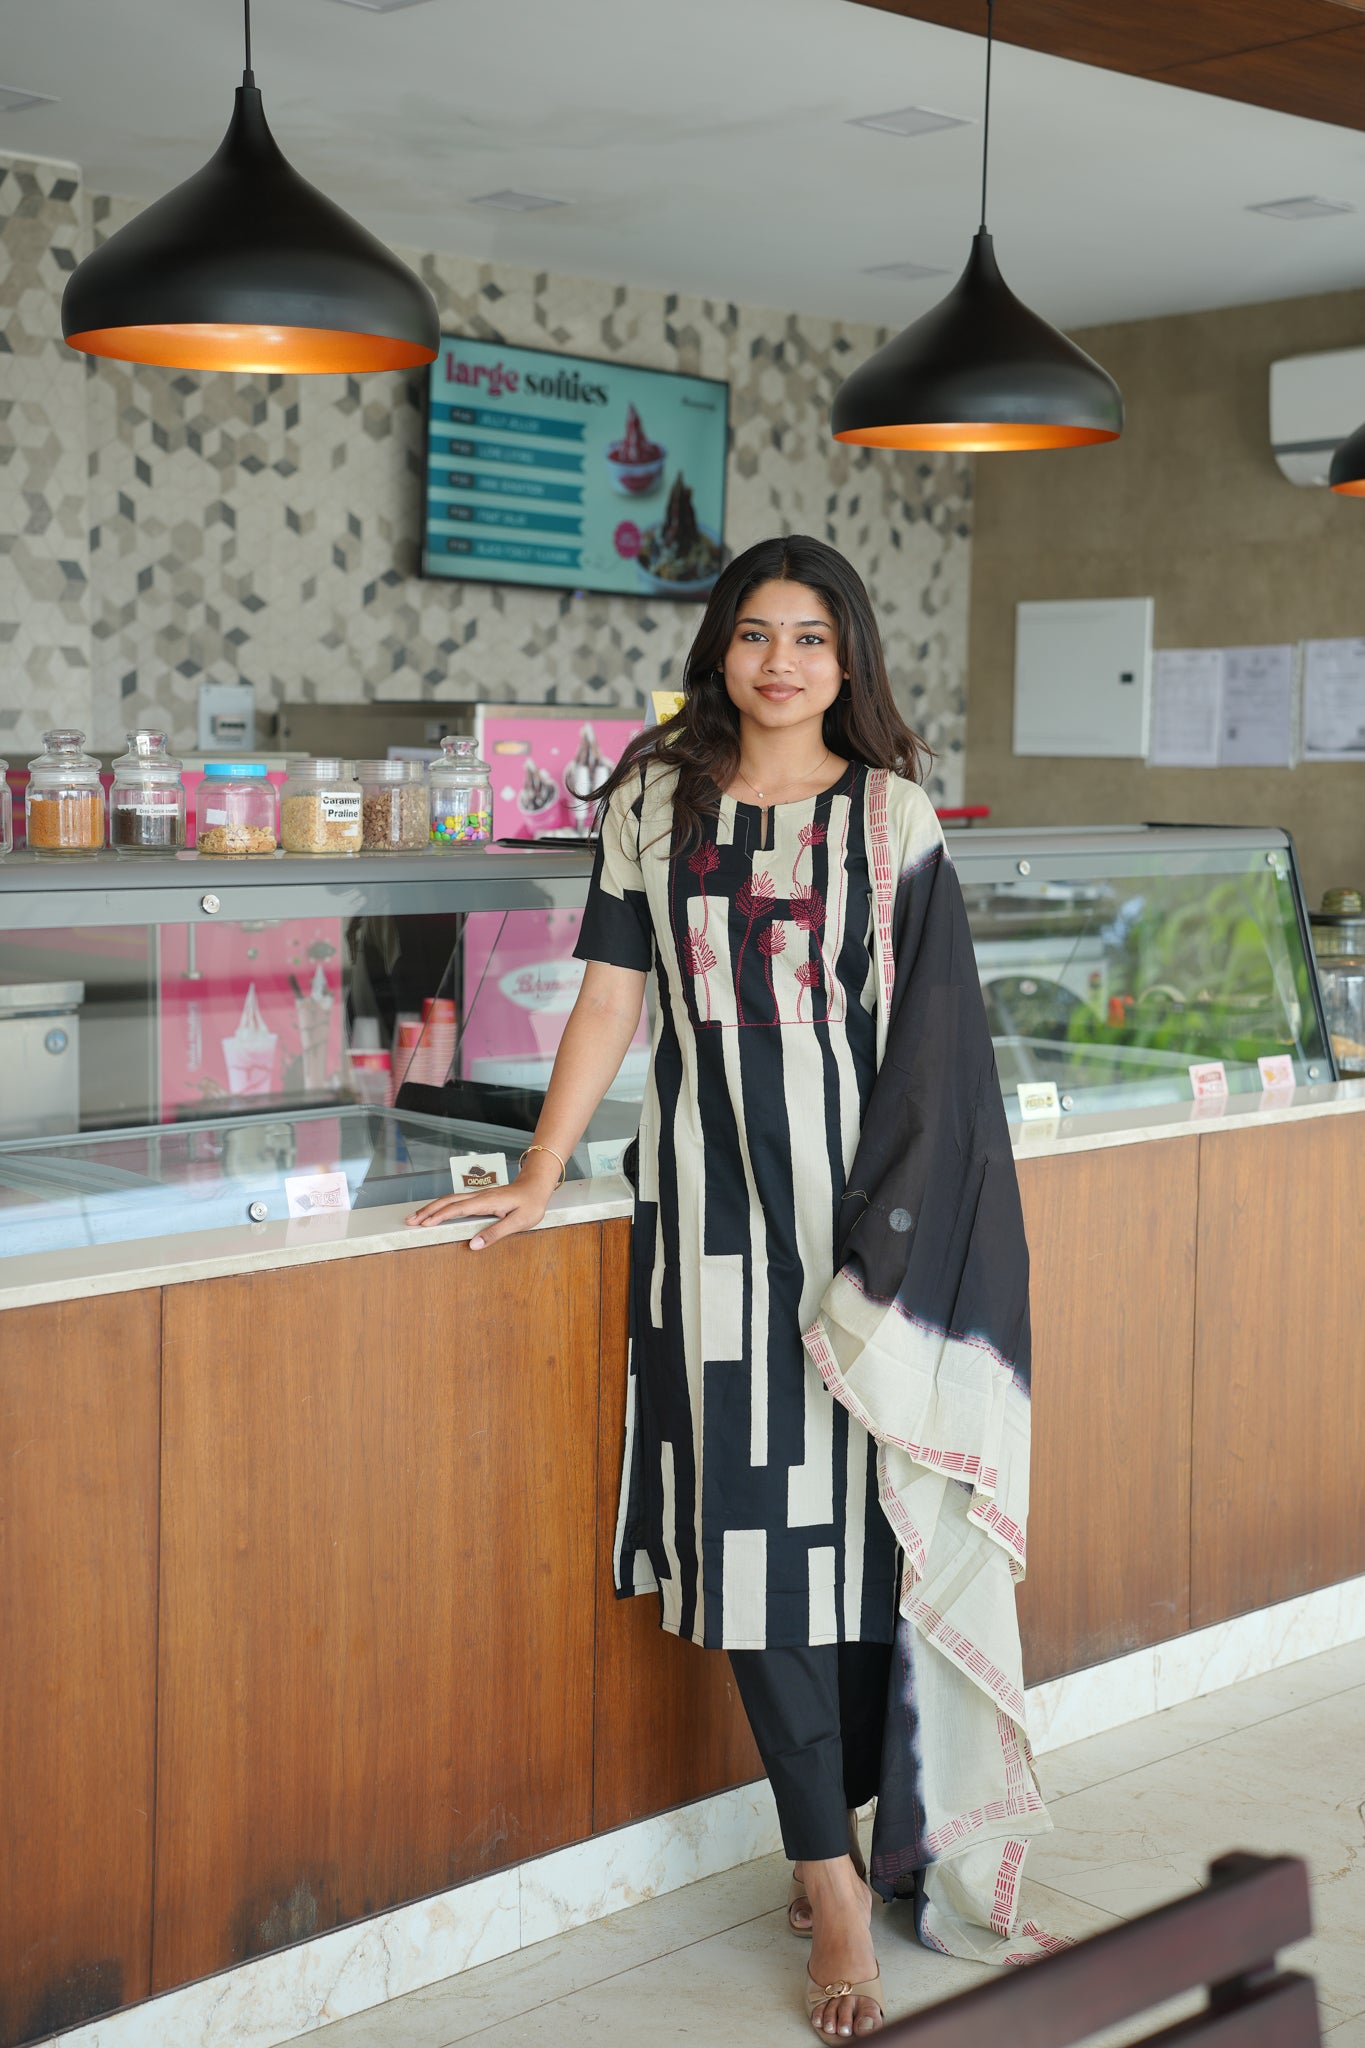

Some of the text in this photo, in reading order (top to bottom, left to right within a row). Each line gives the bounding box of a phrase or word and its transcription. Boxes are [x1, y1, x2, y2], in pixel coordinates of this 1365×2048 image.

[446, 351, 608, 406] large softies
[322, 796, 360, 804] Caramel
[328, 809, 358, 818] Praline
